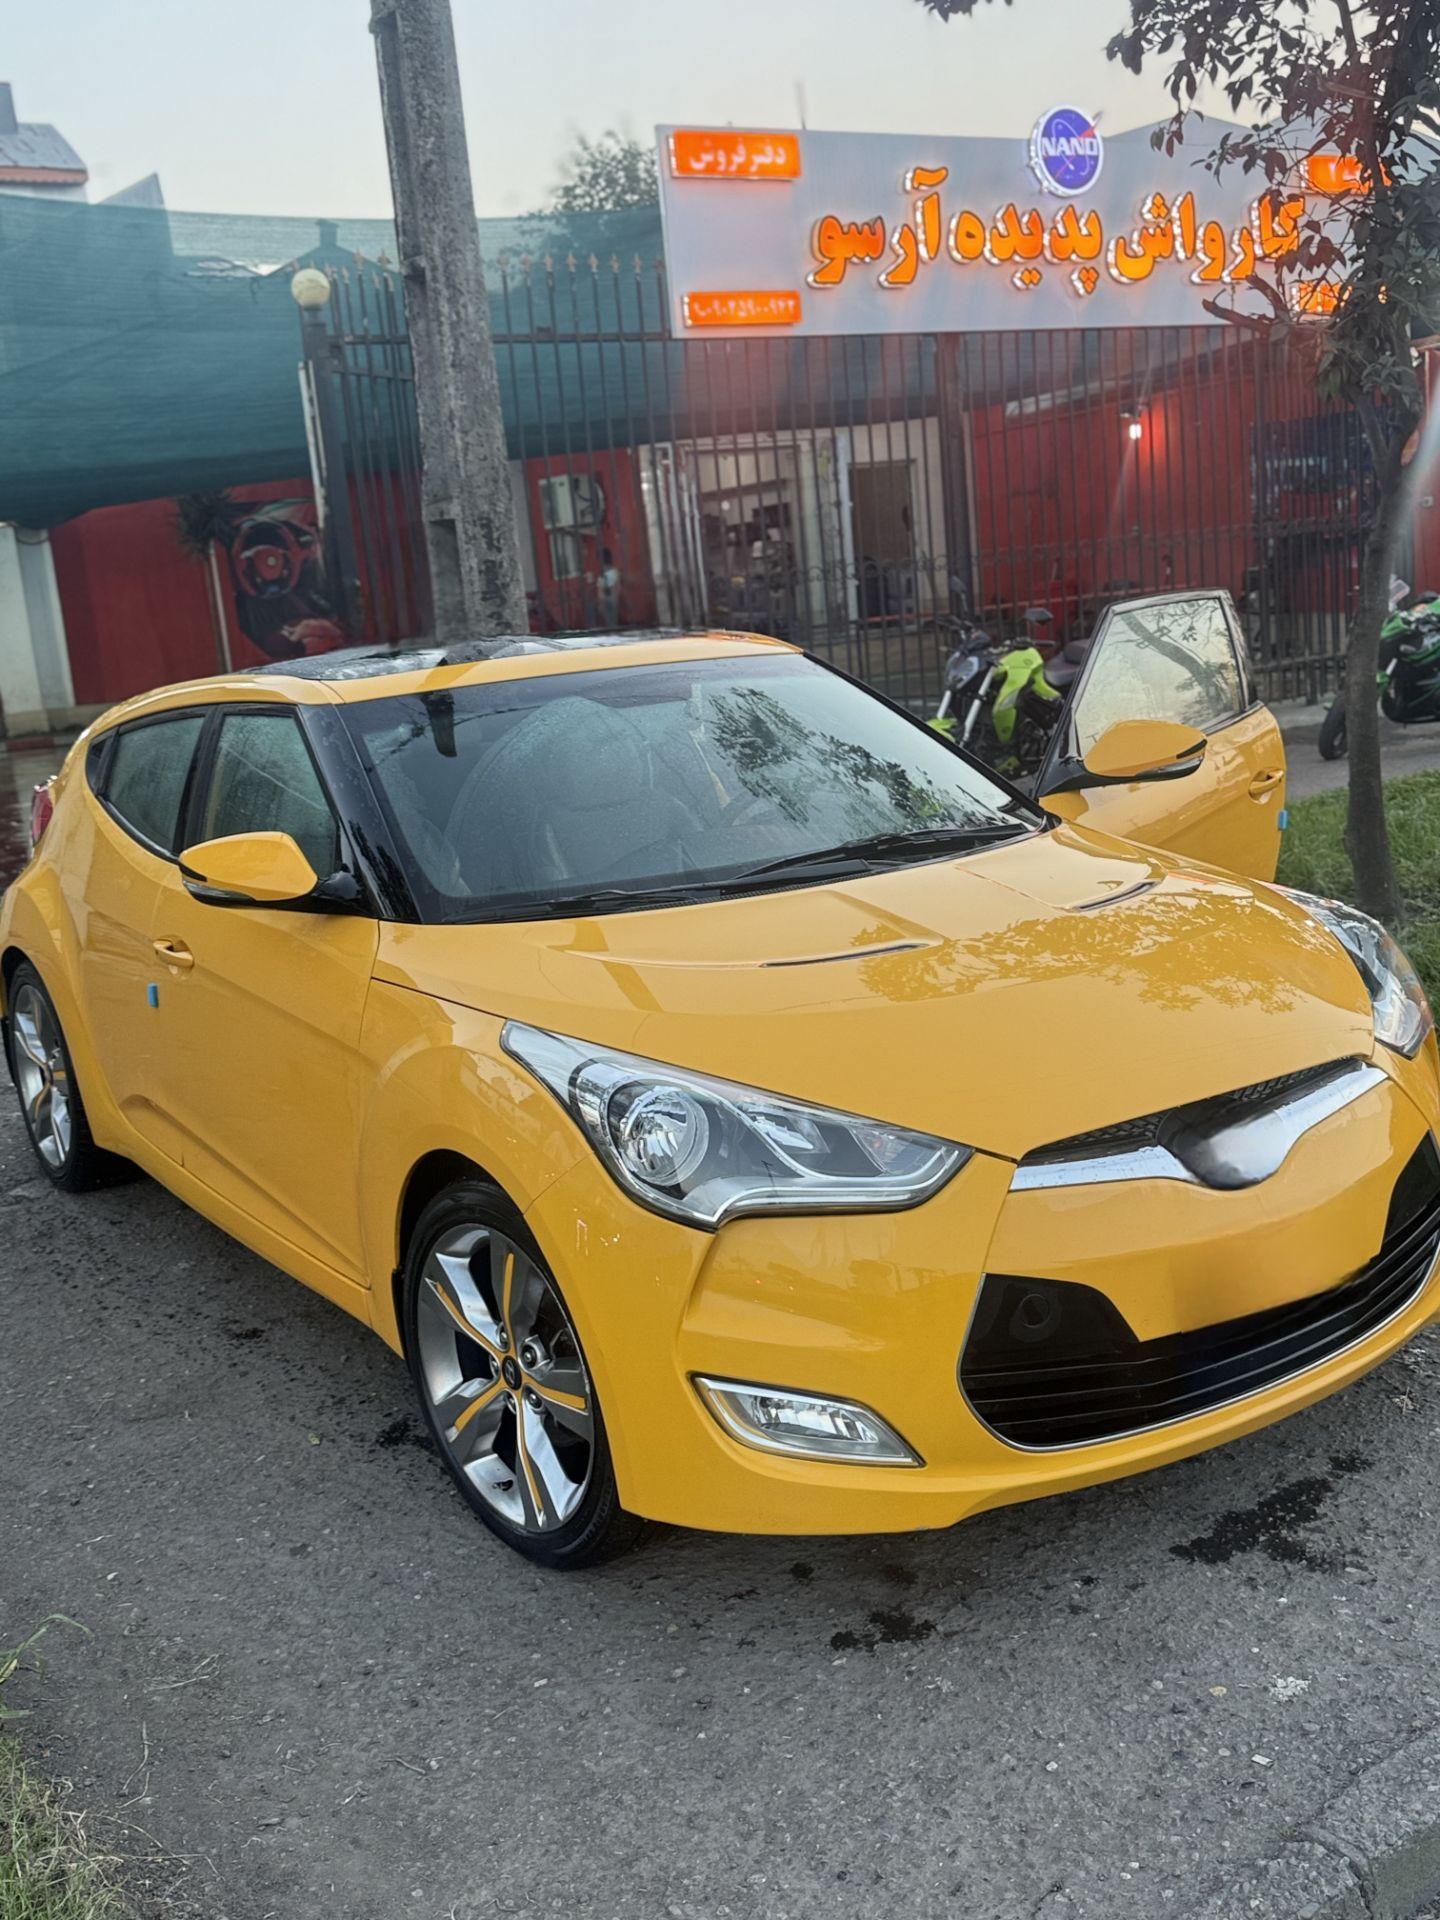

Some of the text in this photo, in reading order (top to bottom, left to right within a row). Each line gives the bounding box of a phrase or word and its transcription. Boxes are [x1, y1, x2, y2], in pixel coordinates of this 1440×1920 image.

[688, 137, 747, 171] فروش
[808, 166, 1304, 295] کارواش پدیده آرسو
